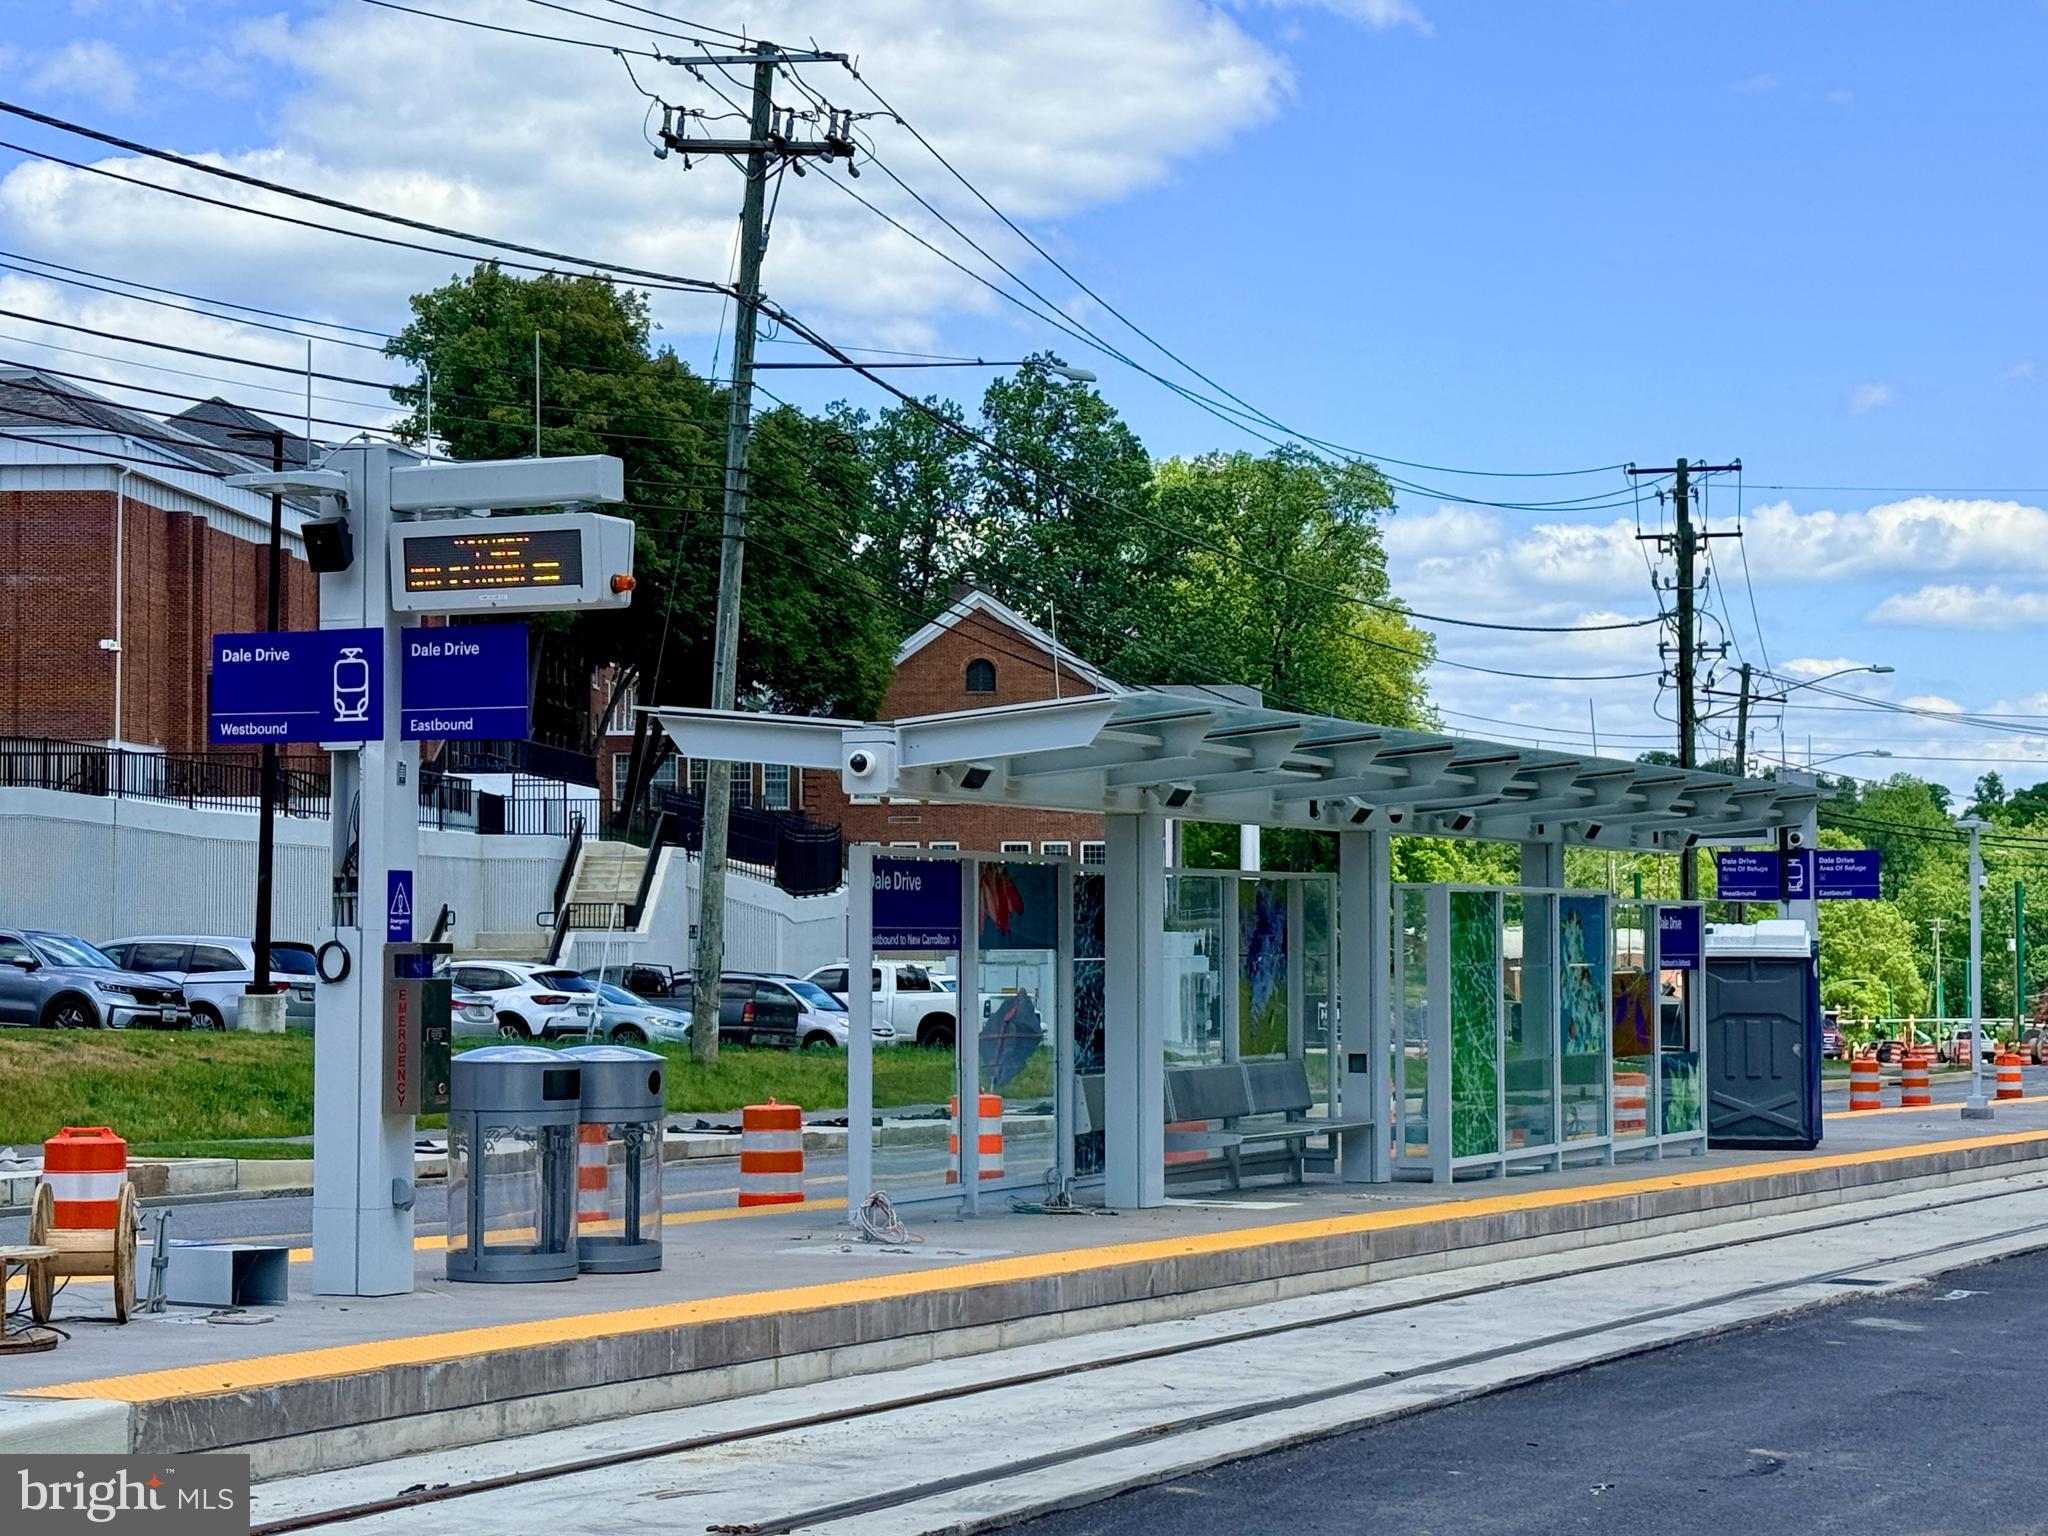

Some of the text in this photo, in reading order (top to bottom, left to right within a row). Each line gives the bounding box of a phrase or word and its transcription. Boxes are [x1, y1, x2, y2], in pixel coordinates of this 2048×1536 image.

[222, 647, 290, 663] Dale Drive
[411, 641, 480, 657] Dale Drive
[220, 722, 288, 736] Westbound
[410, 717, 474, 732] Eastbound
[1721, 857, 1757, 865] Dale Drive
[1818, 856, 1855, 864] Dale Drive
[1738, 865, 1746, 873] Of
[1747, 865, 1769, 874] Refuge
[1835, 864, 1843, 872] Of
[1845, 864, 1867, 873] Refuge
[894, 870, 922, 891] Drive
[1818, 889, 1853, 897] Eastbound
[900, 935, 906, 945] to
[907, 934, 921, 945] New
[397, 989, 407, 1107] EMERGENCY
